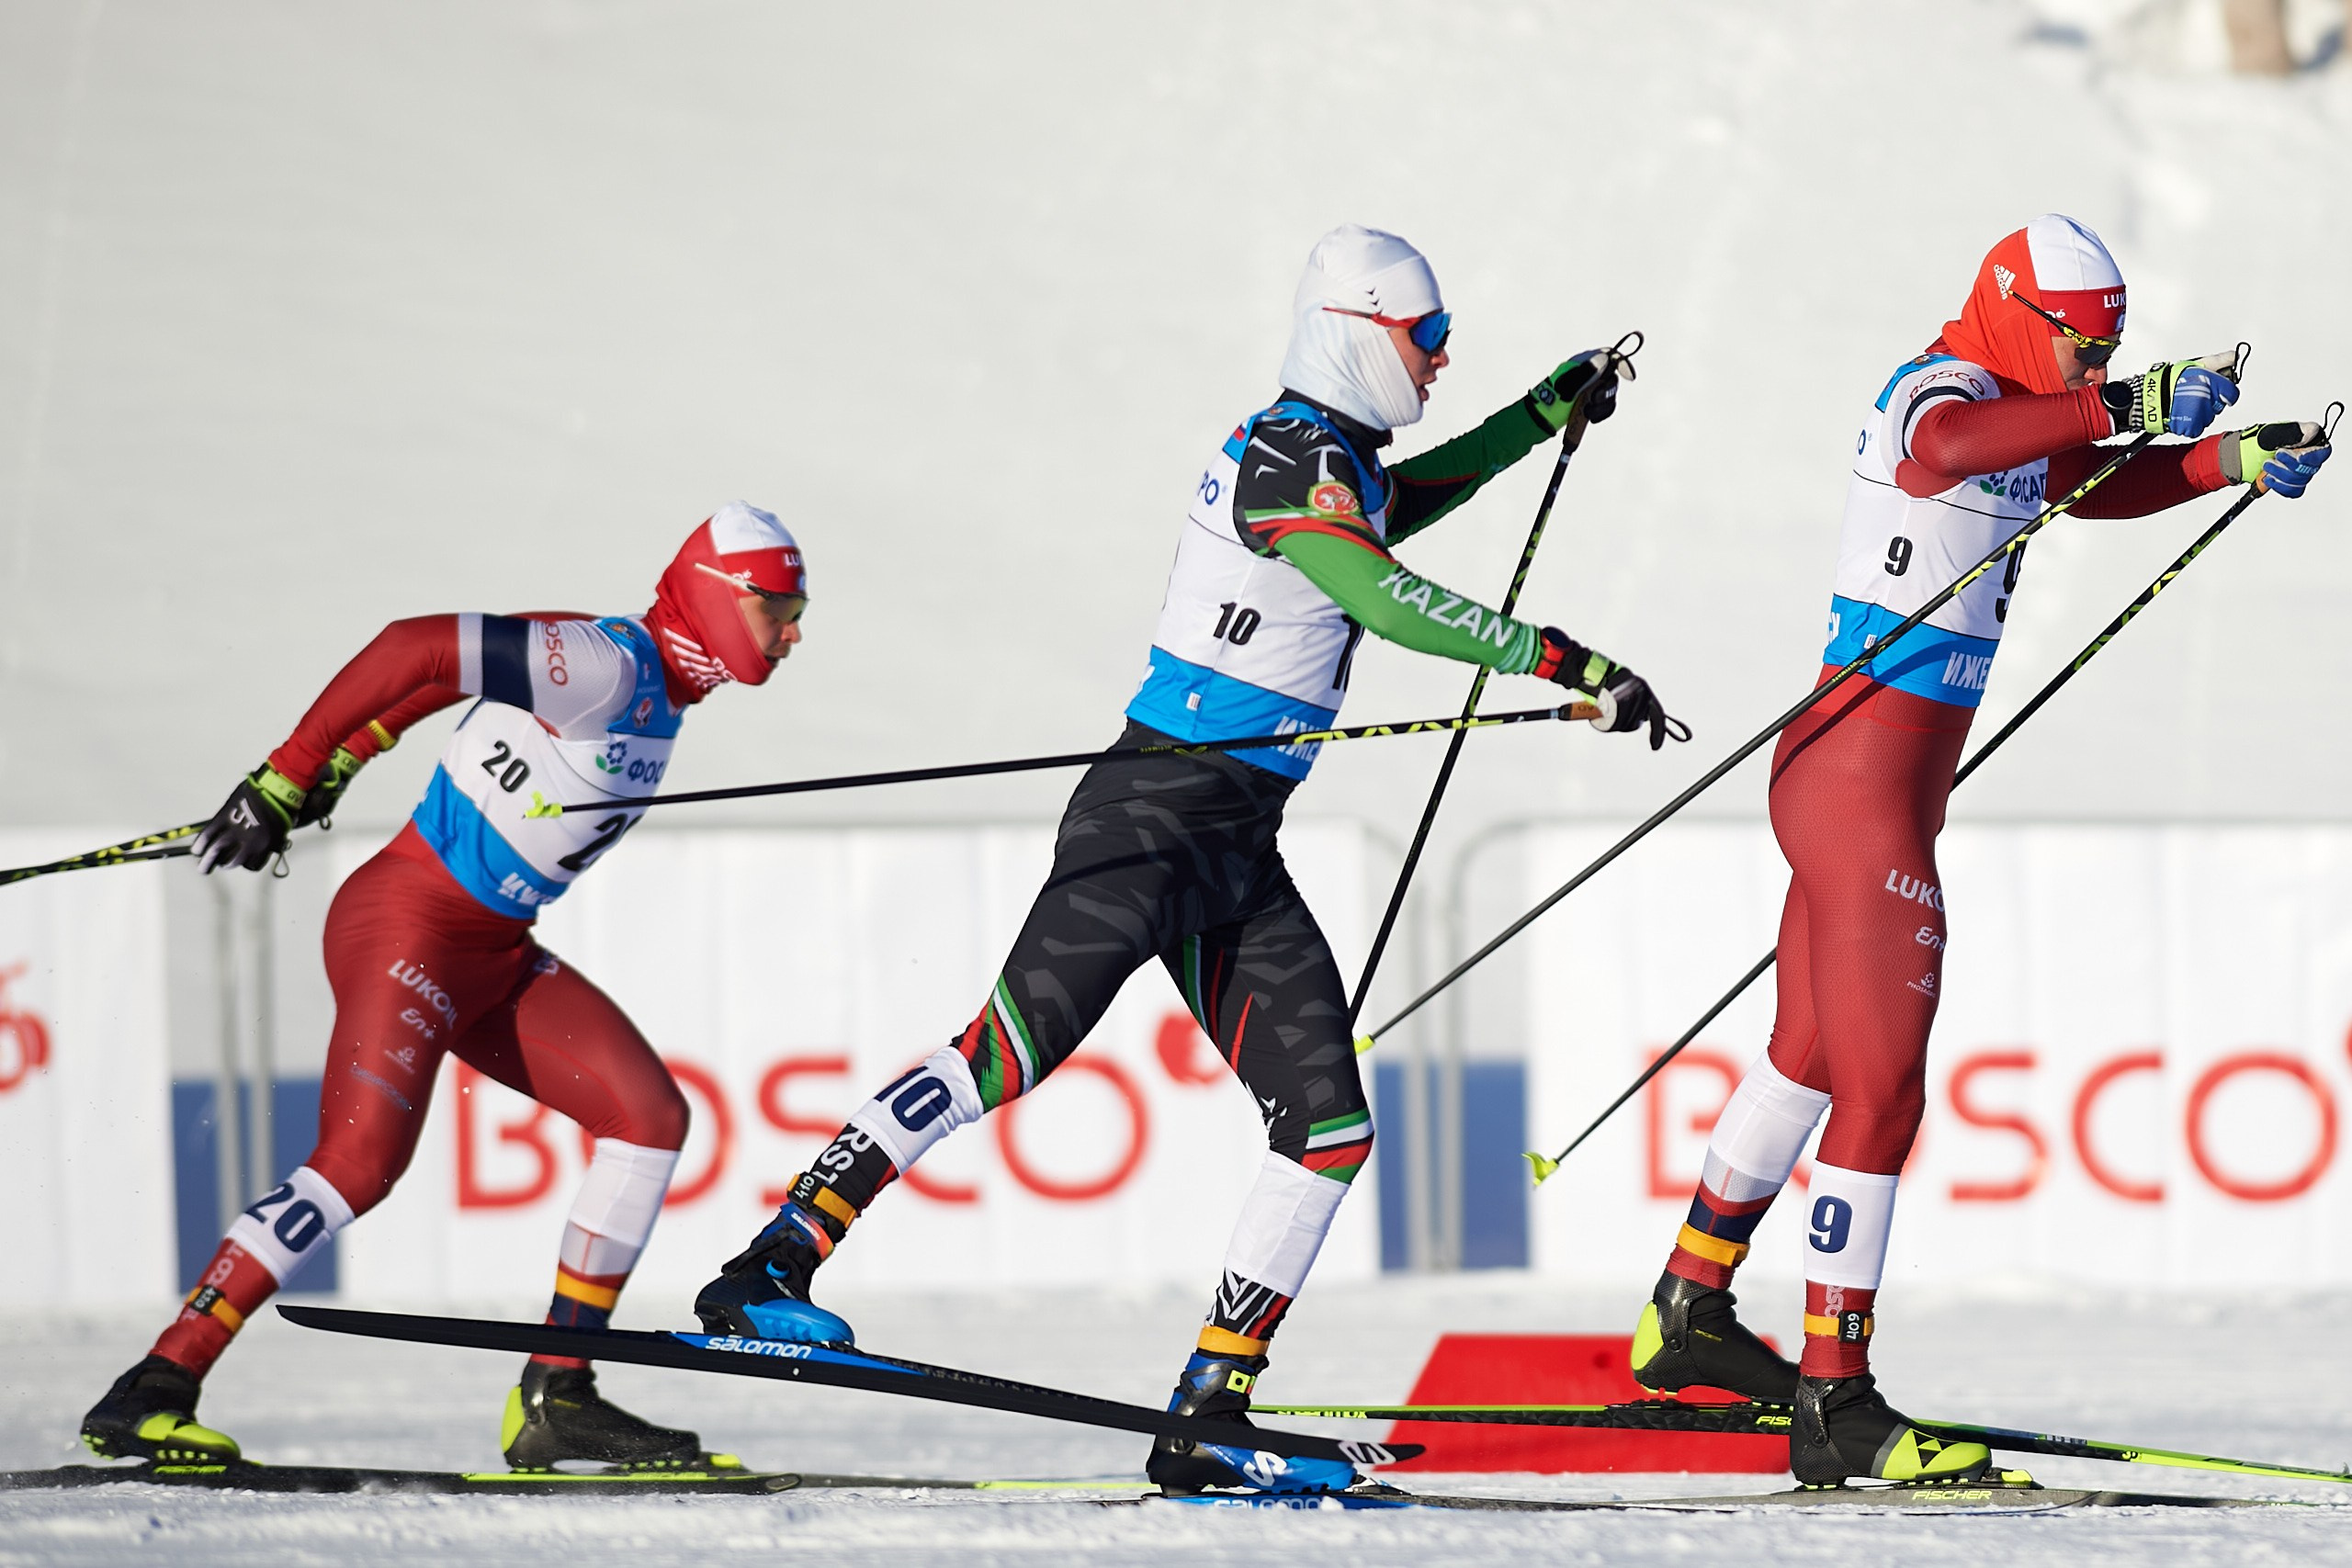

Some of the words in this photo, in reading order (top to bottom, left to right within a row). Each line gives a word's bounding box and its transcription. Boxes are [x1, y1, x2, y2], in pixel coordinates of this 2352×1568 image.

[1994, 264, 2008, 300] adidas
[1909, 370, 1984, 400] BOSCO
[1884, 536, 1913, 576] 9
[1213, 602, 1261, 646] 10
[1378, 570, 1515, 648] KAZAN
[545, 622, 568, 686] OSCO
[481, 740, 530, 793] 20
[388, 958, 458, 1030] LUKOIL
[873, 1066, 952, 1133] 10
[795, 1176, 815, 1199] 410
[245, 1181, 326, 1253] 20
[1809, 1195, 1853, 1253] 9
[1846, 1313, 1860, 1339] 409
[1912, 1490, 1993, 1500] FISCHER
